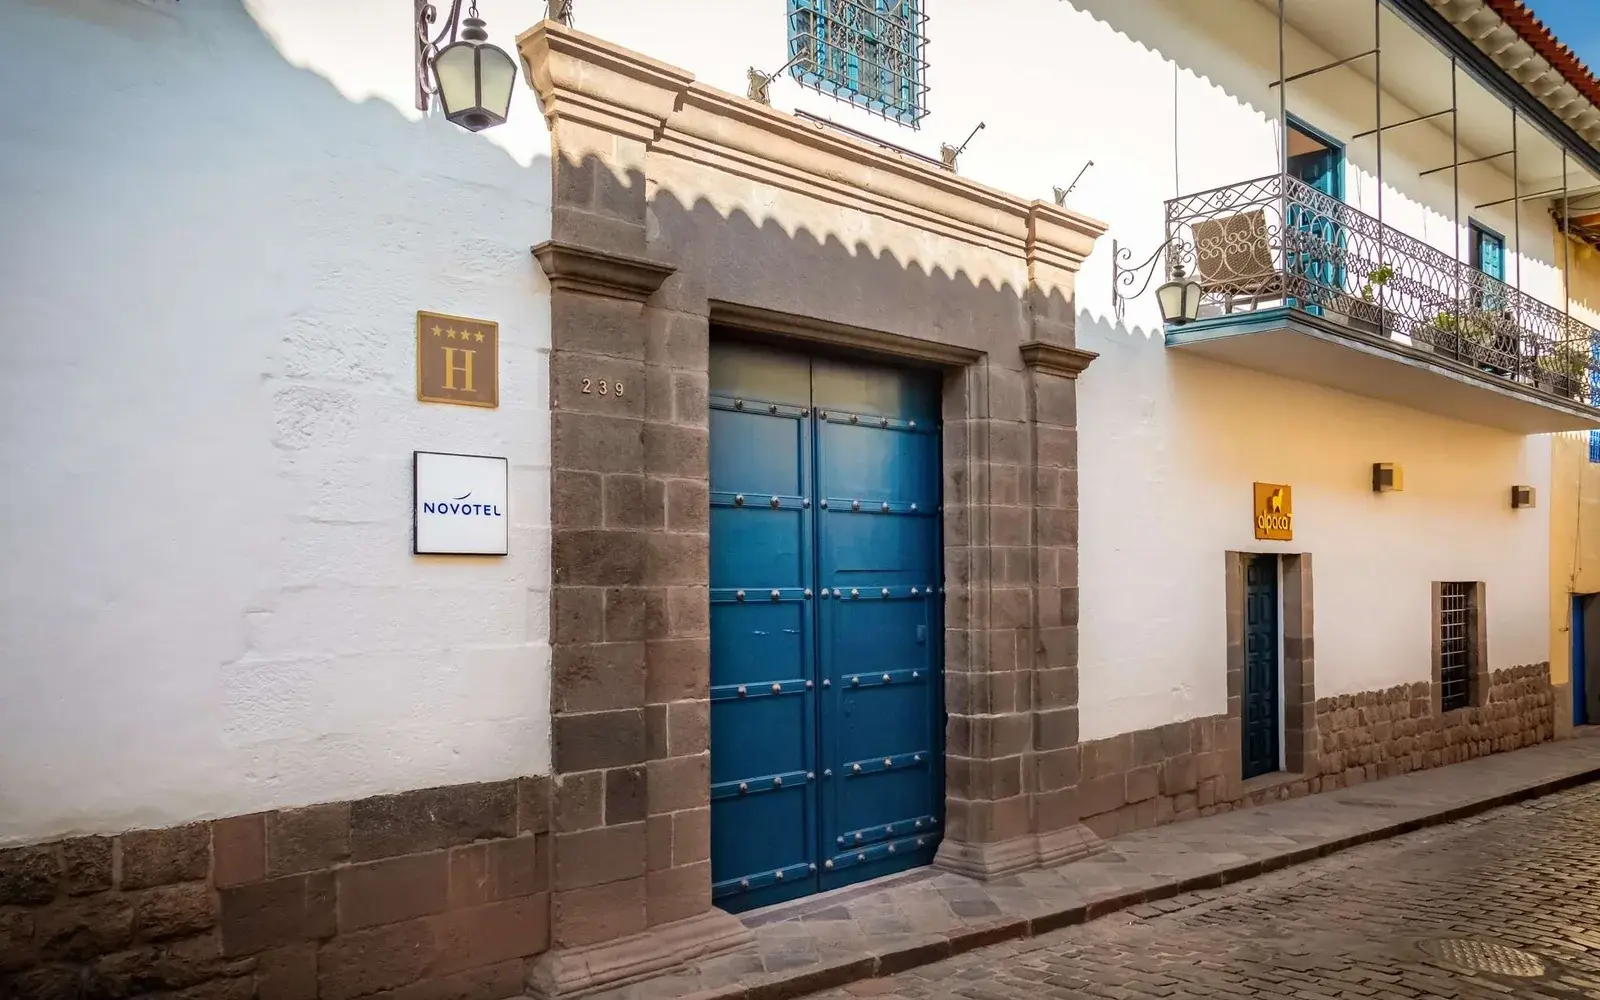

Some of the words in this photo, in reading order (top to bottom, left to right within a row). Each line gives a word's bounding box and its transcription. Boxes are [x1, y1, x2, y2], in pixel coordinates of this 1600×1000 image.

[441, 346, 476, 392] H
[582, 378, 624, 397] 239
[423, 502, 501, 516] NOVOTEL
